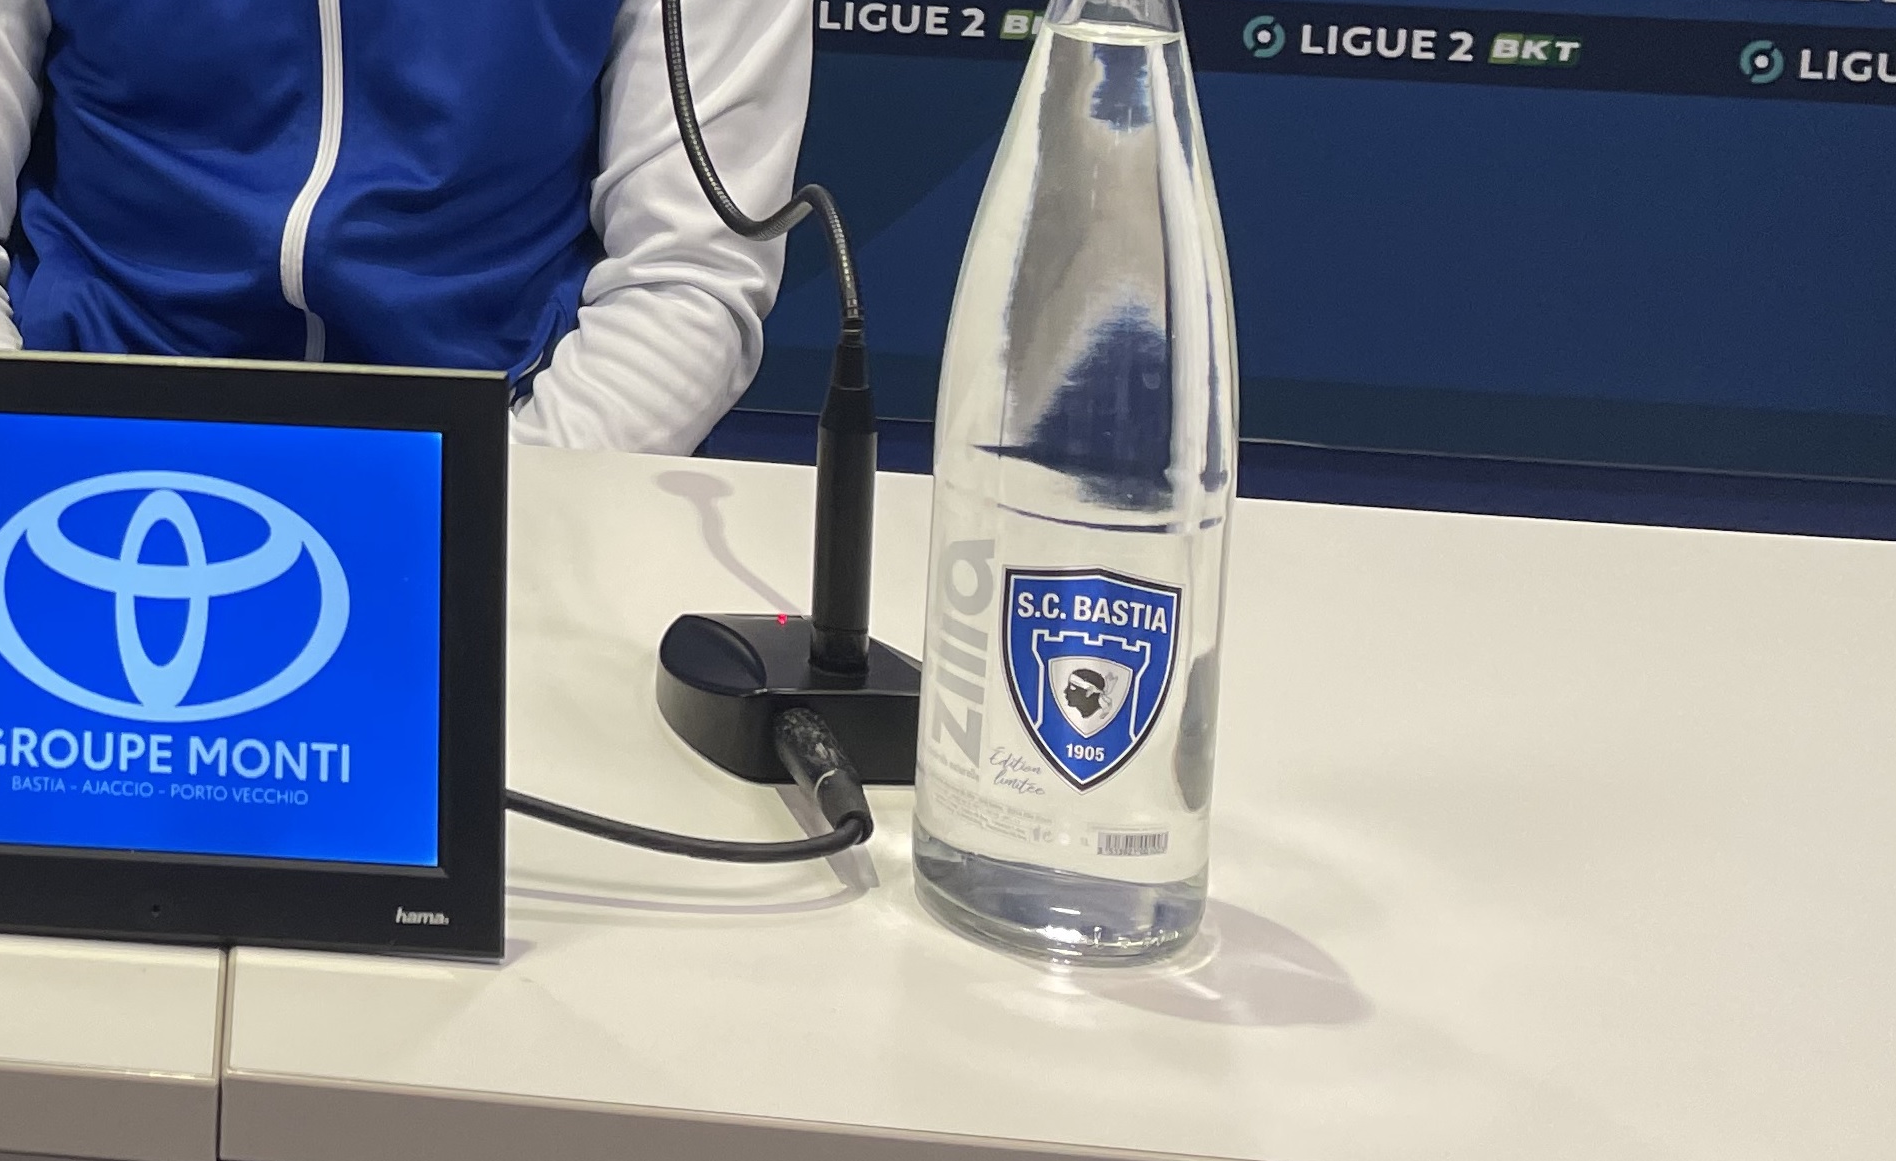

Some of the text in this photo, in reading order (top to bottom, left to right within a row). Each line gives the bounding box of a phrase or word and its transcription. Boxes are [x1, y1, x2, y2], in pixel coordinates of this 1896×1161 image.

[1017, 592, 1168, 634] S.C. BASTIA
[188, 736, 351, 783] MONTI
[1065, 742, 1106, 763] 1905
[11, 776, 309, 807] BASTIA AJACCIO PORTO VECCHIO
